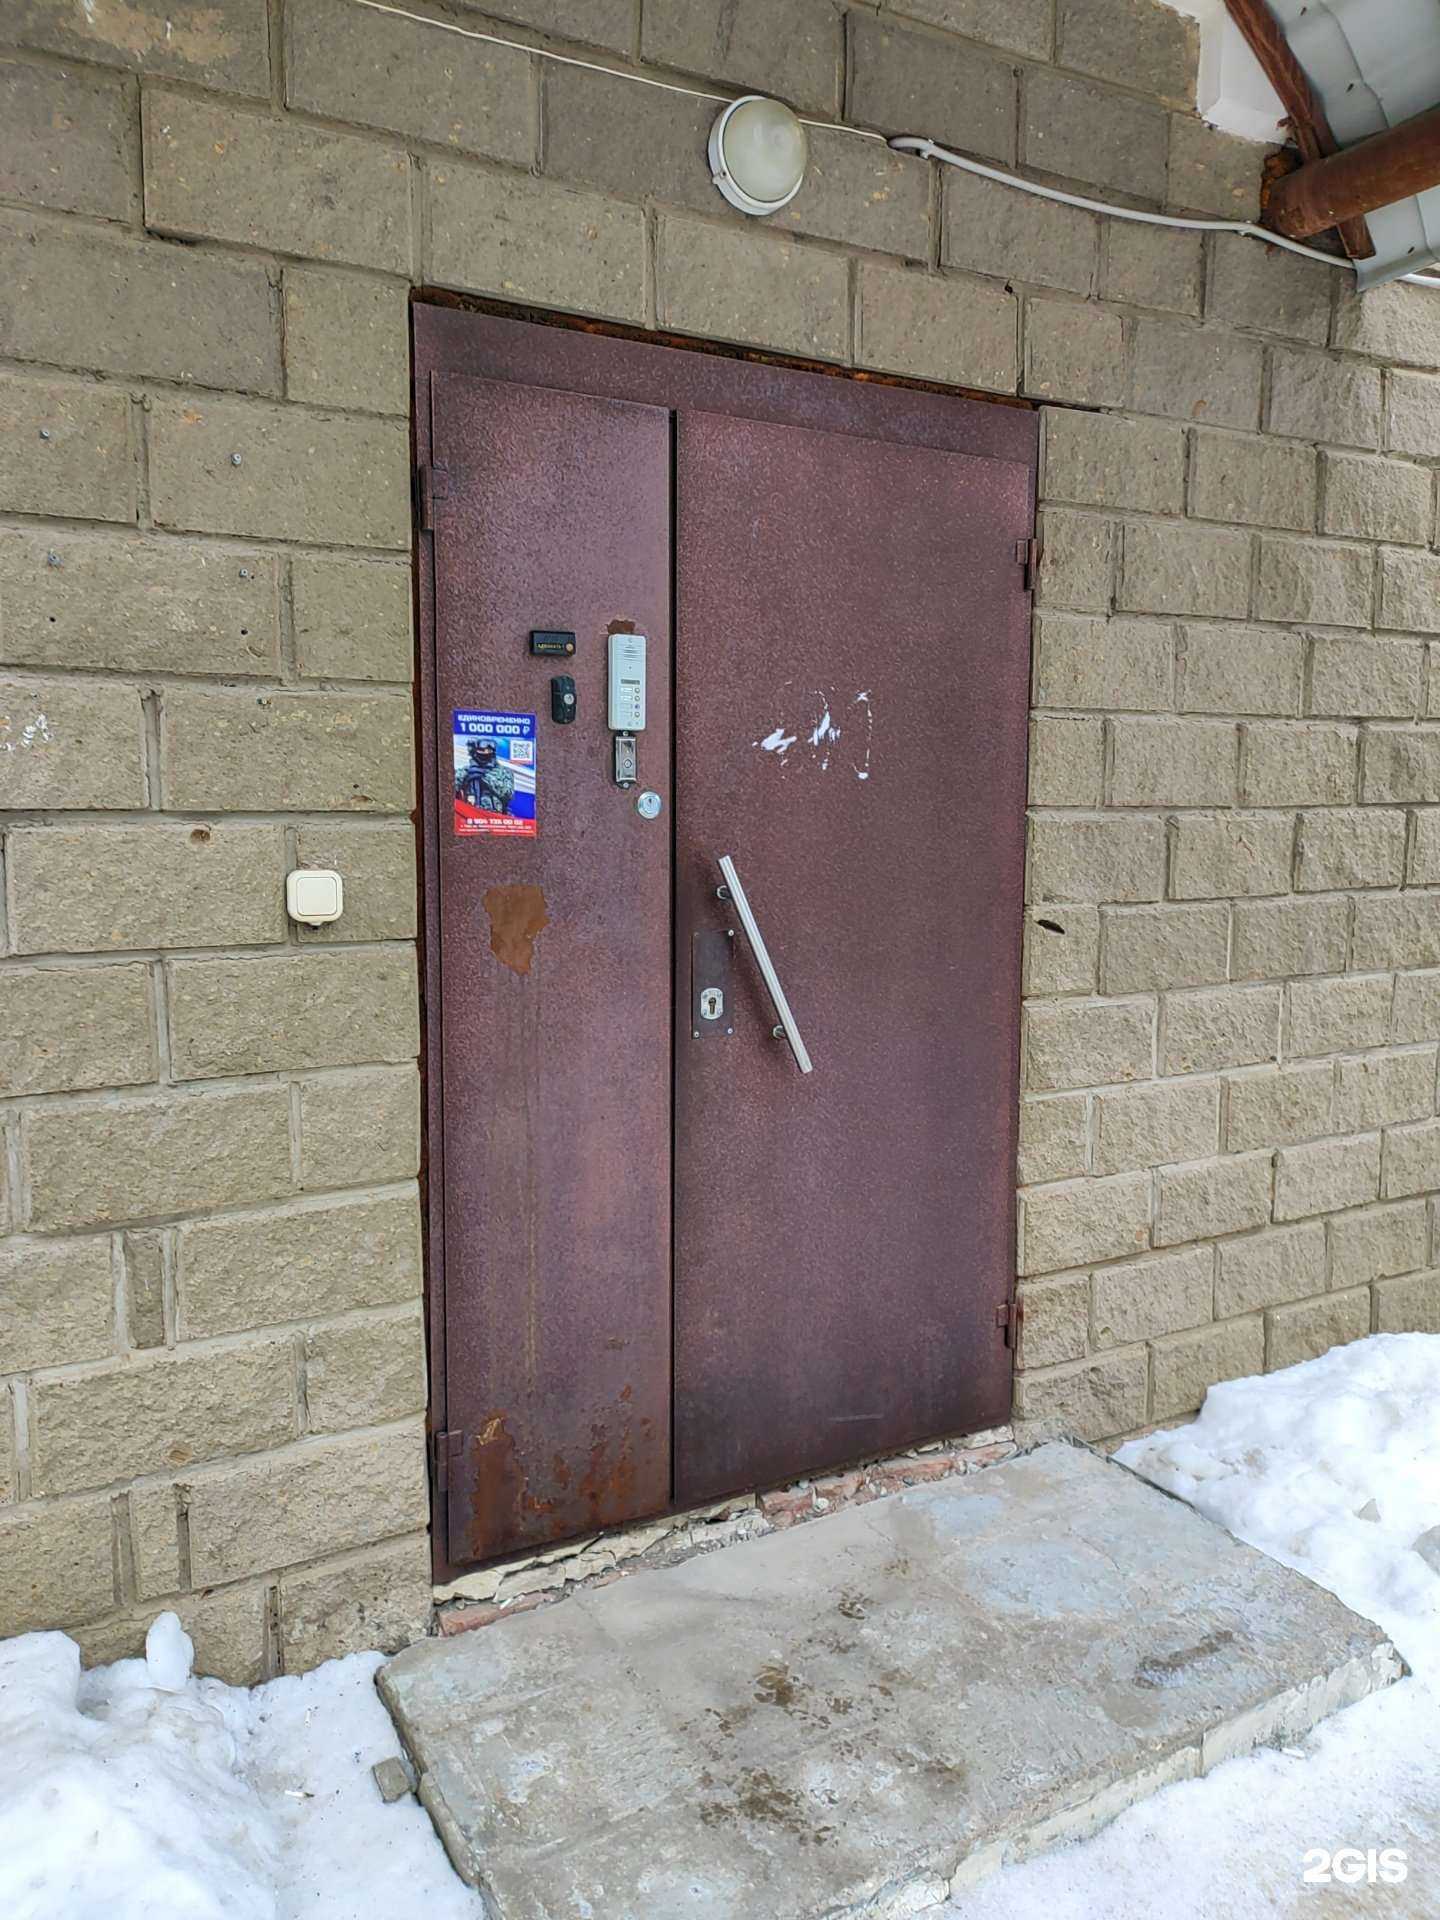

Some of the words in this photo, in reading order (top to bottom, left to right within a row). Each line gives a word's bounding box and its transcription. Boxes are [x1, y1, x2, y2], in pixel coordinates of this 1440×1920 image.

[457, 714, 531, 724] ЕДИНОВРЕМЕННО
[461, 723, 466, 732] 1
[469, 723, 493, 733] 000
[496, 725, 520, 734] 000
